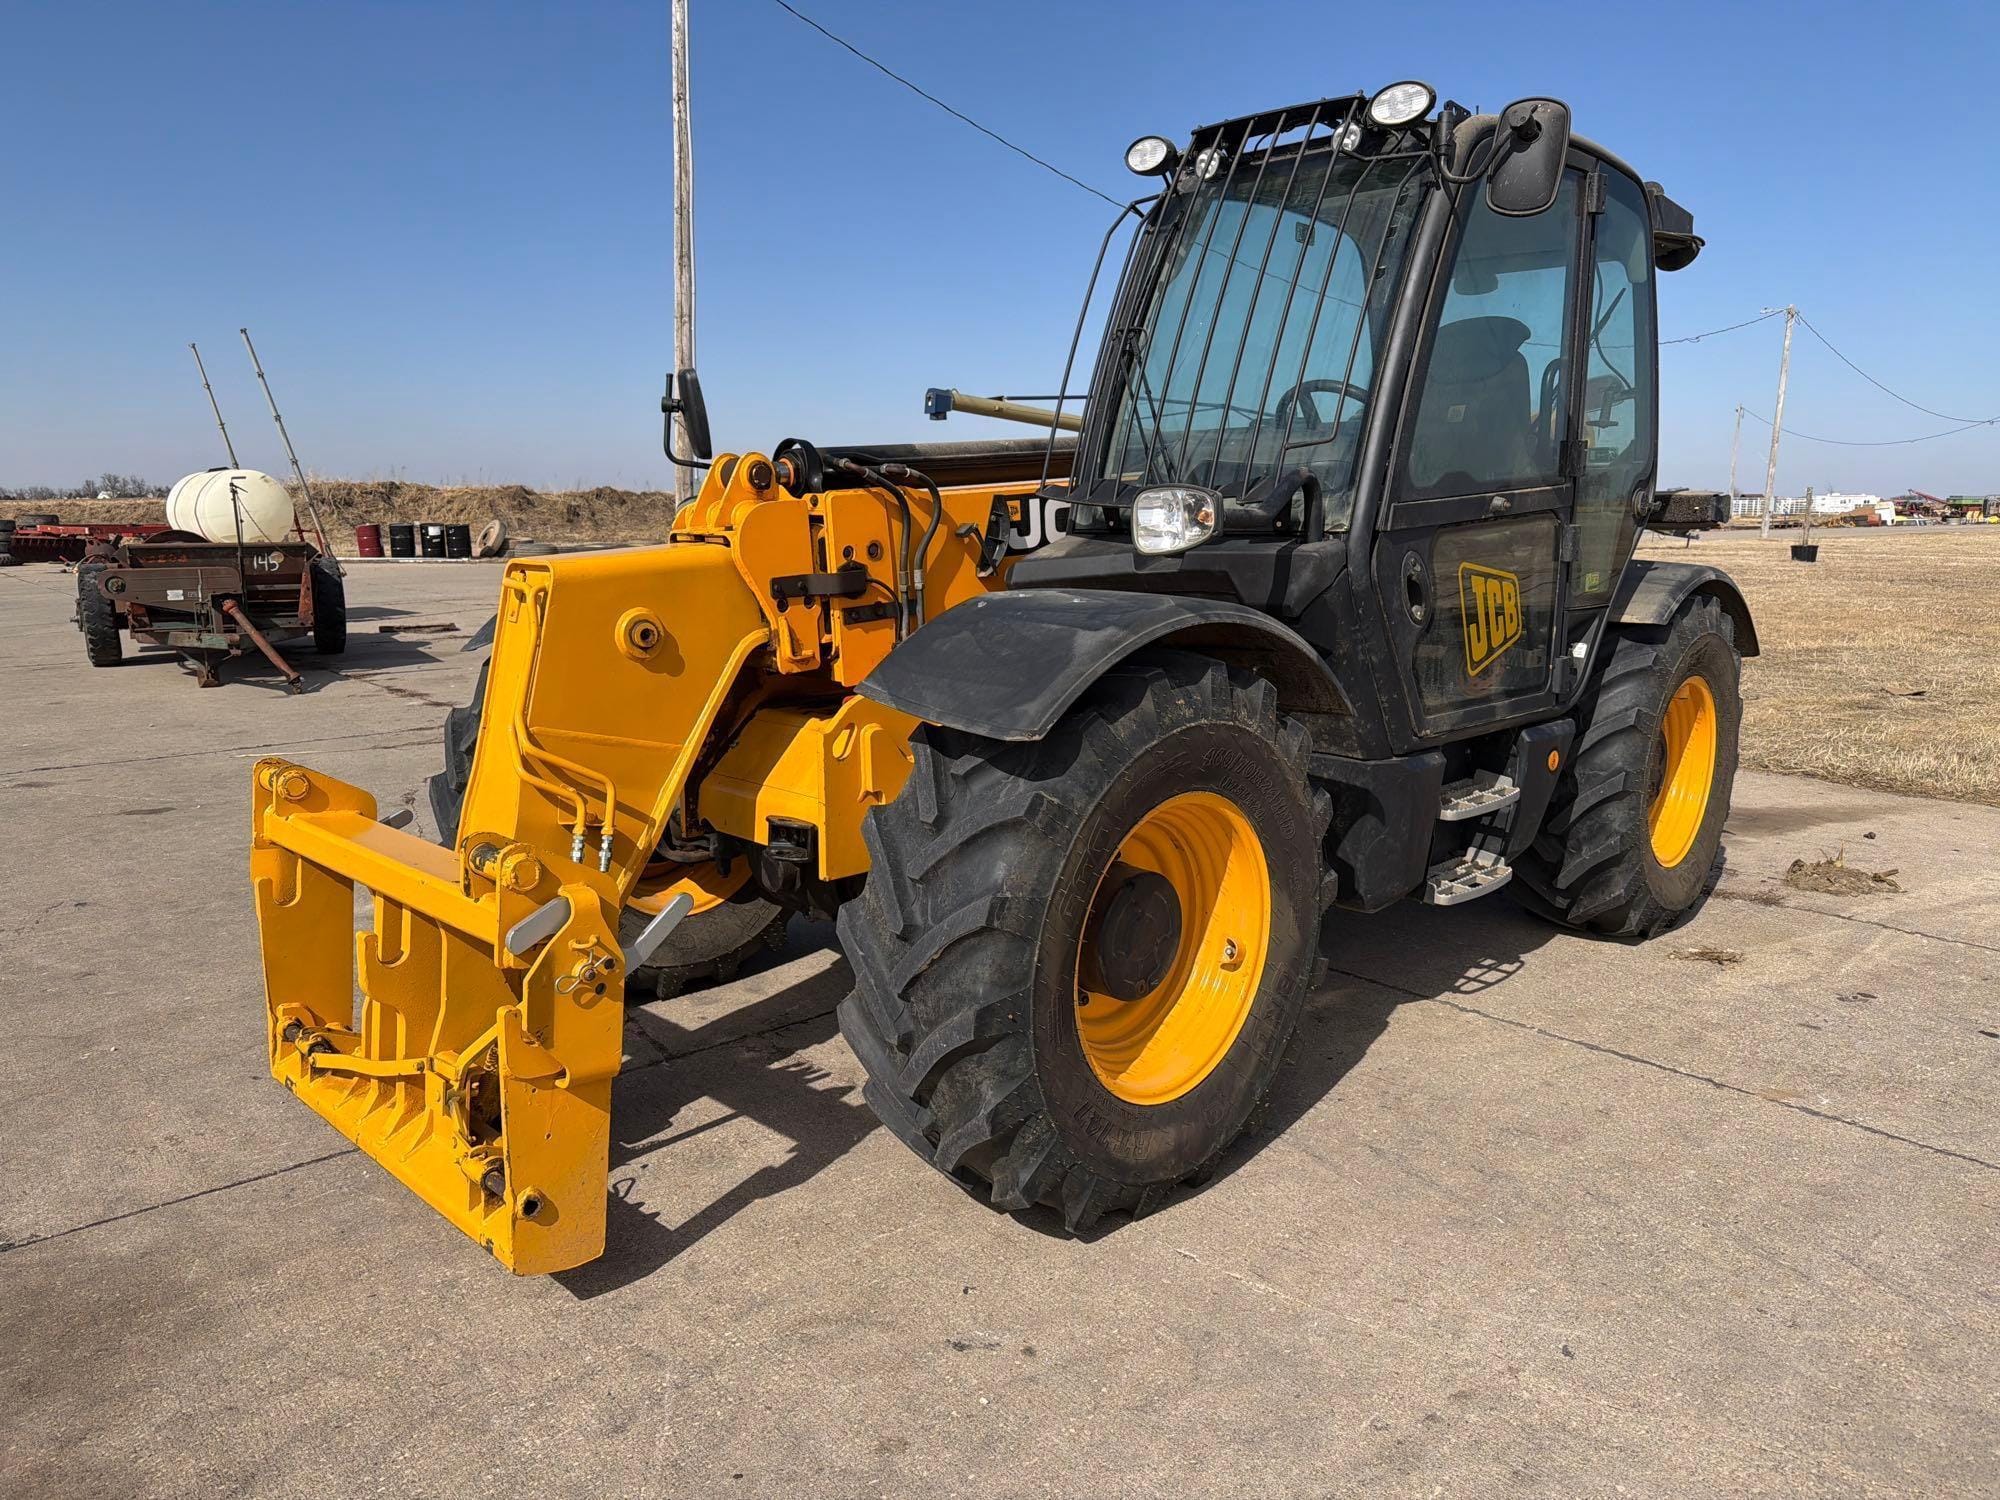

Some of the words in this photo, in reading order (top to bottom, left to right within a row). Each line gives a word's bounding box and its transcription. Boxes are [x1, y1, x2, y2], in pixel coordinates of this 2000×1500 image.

[1009, 498, 1071, 549] JC
[253, 552, 279, 571] 145
[1470, 575, 1518, 662] JCB
